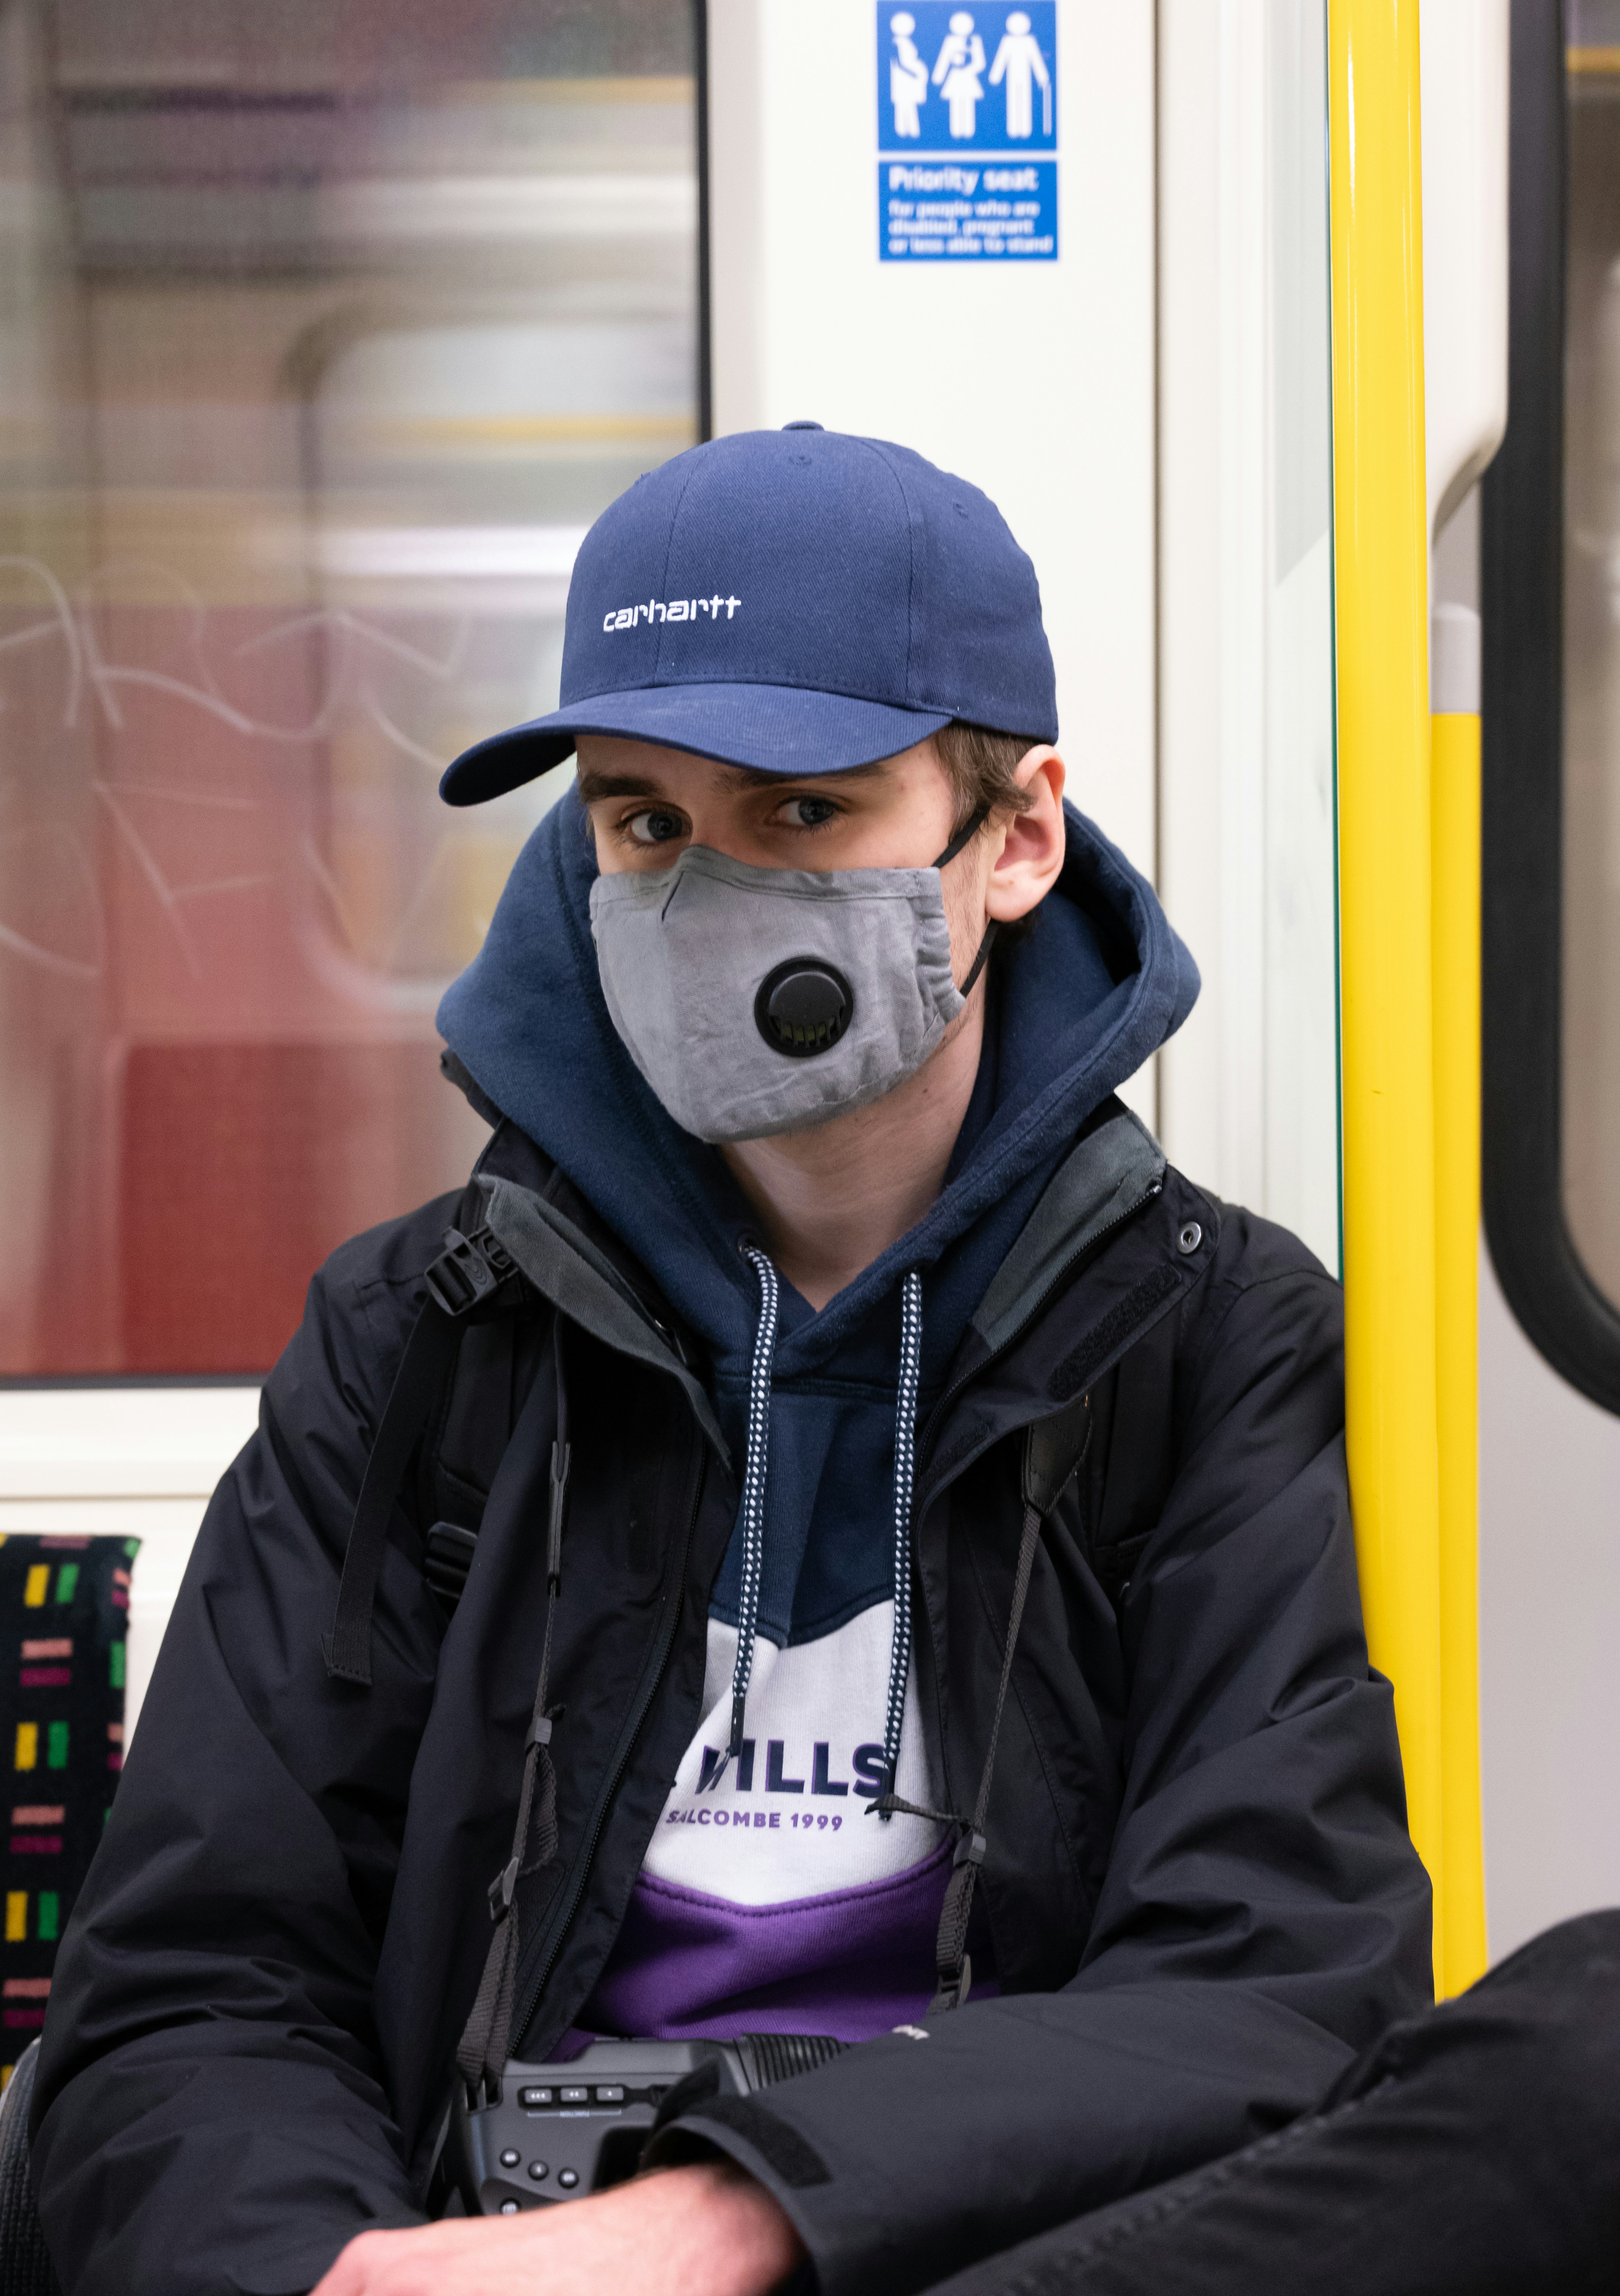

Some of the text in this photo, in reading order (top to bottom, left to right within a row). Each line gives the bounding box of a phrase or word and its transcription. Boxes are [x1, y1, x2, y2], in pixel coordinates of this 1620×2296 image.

[889, 166, 1038, 196] Priority seat
[603, 595, 741, 632] carhartt
[791, 1812, 843, 1831] 1999
